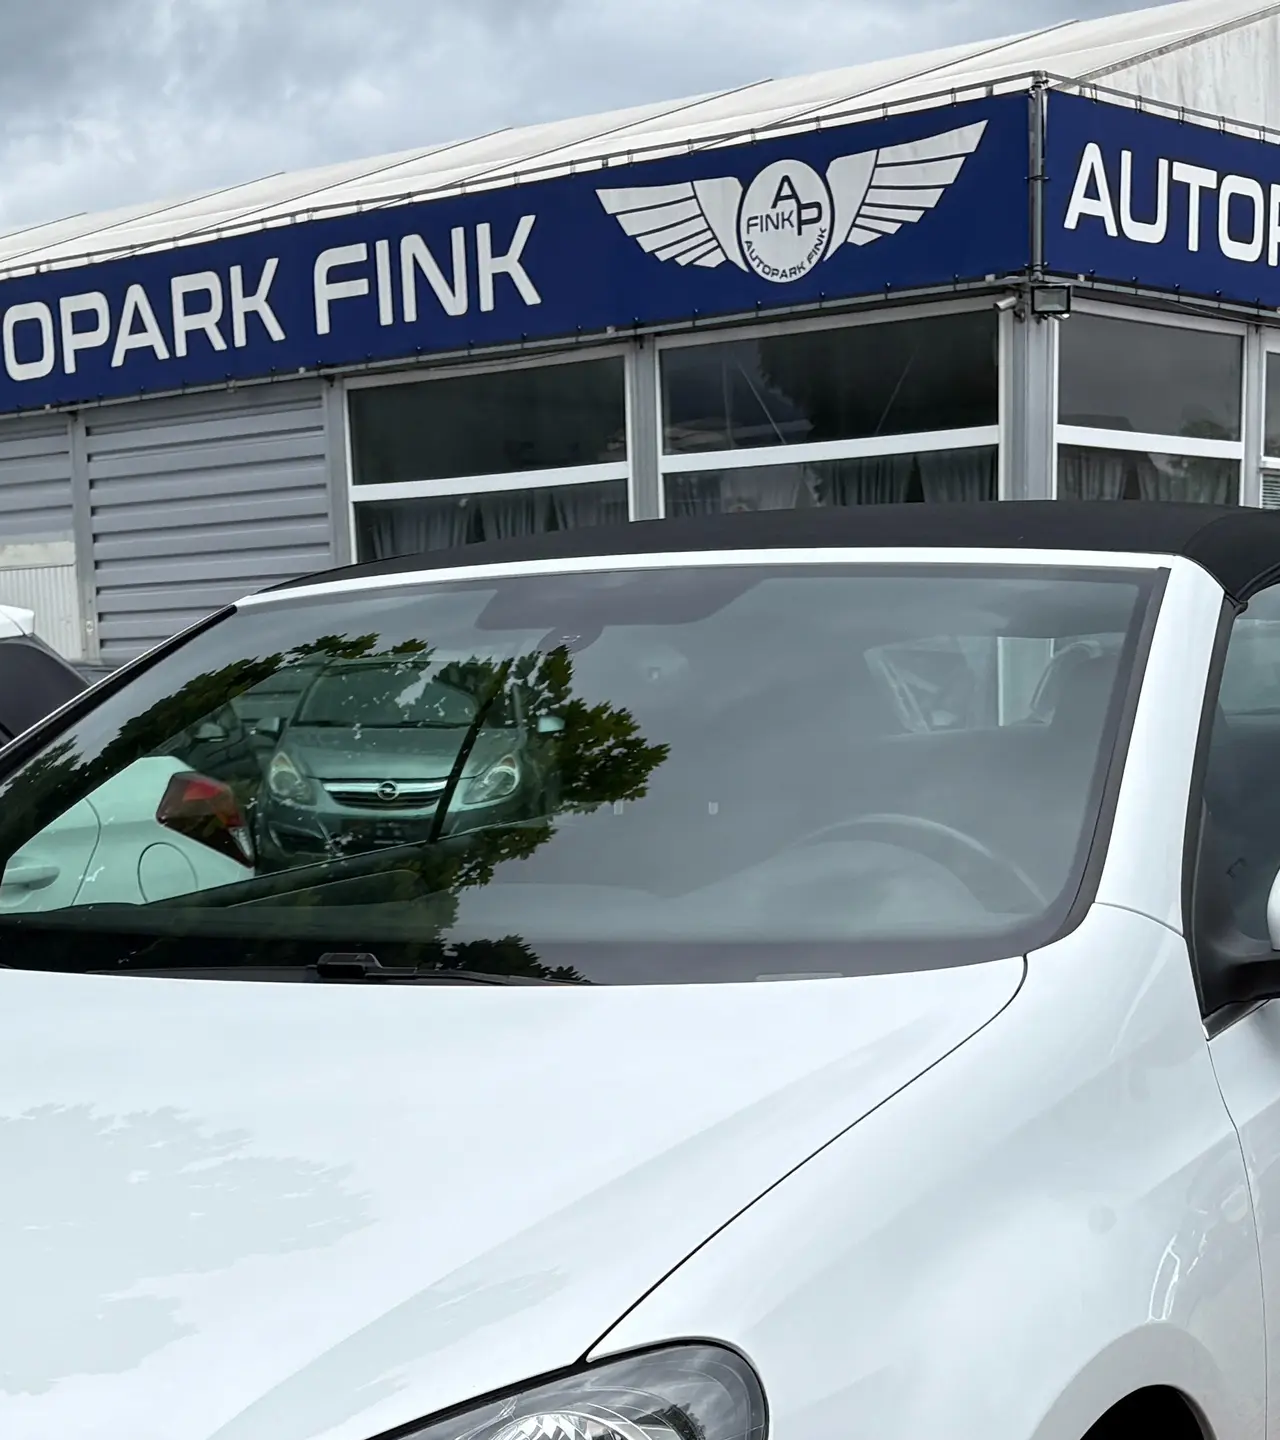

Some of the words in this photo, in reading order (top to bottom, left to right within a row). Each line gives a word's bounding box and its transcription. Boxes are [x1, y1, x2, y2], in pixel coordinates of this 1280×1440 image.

[746, 210, 795, 235] FINK
[314, 214, 542, 335] FINK
[744, 240, 806, 279] AUTOPARK
[807, 227, 827, 265] FINK
